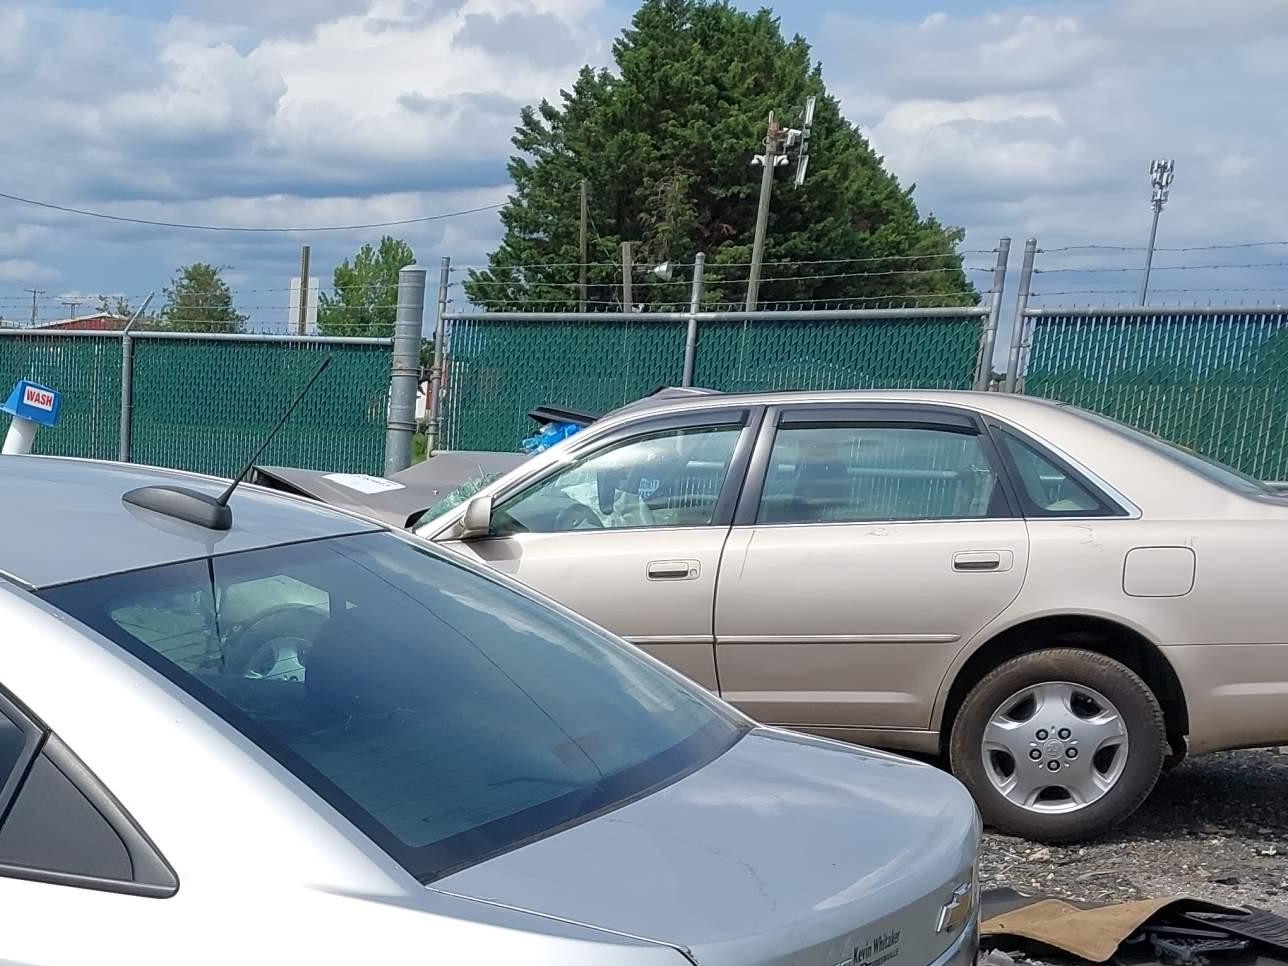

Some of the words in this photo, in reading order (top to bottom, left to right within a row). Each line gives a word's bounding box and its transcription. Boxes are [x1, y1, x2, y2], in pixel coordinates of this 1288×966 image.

[26, 389, 53, 407] WASH
[853, 941, 872, 964] Kevin
[873, 928, 900, 953] Whitaker
